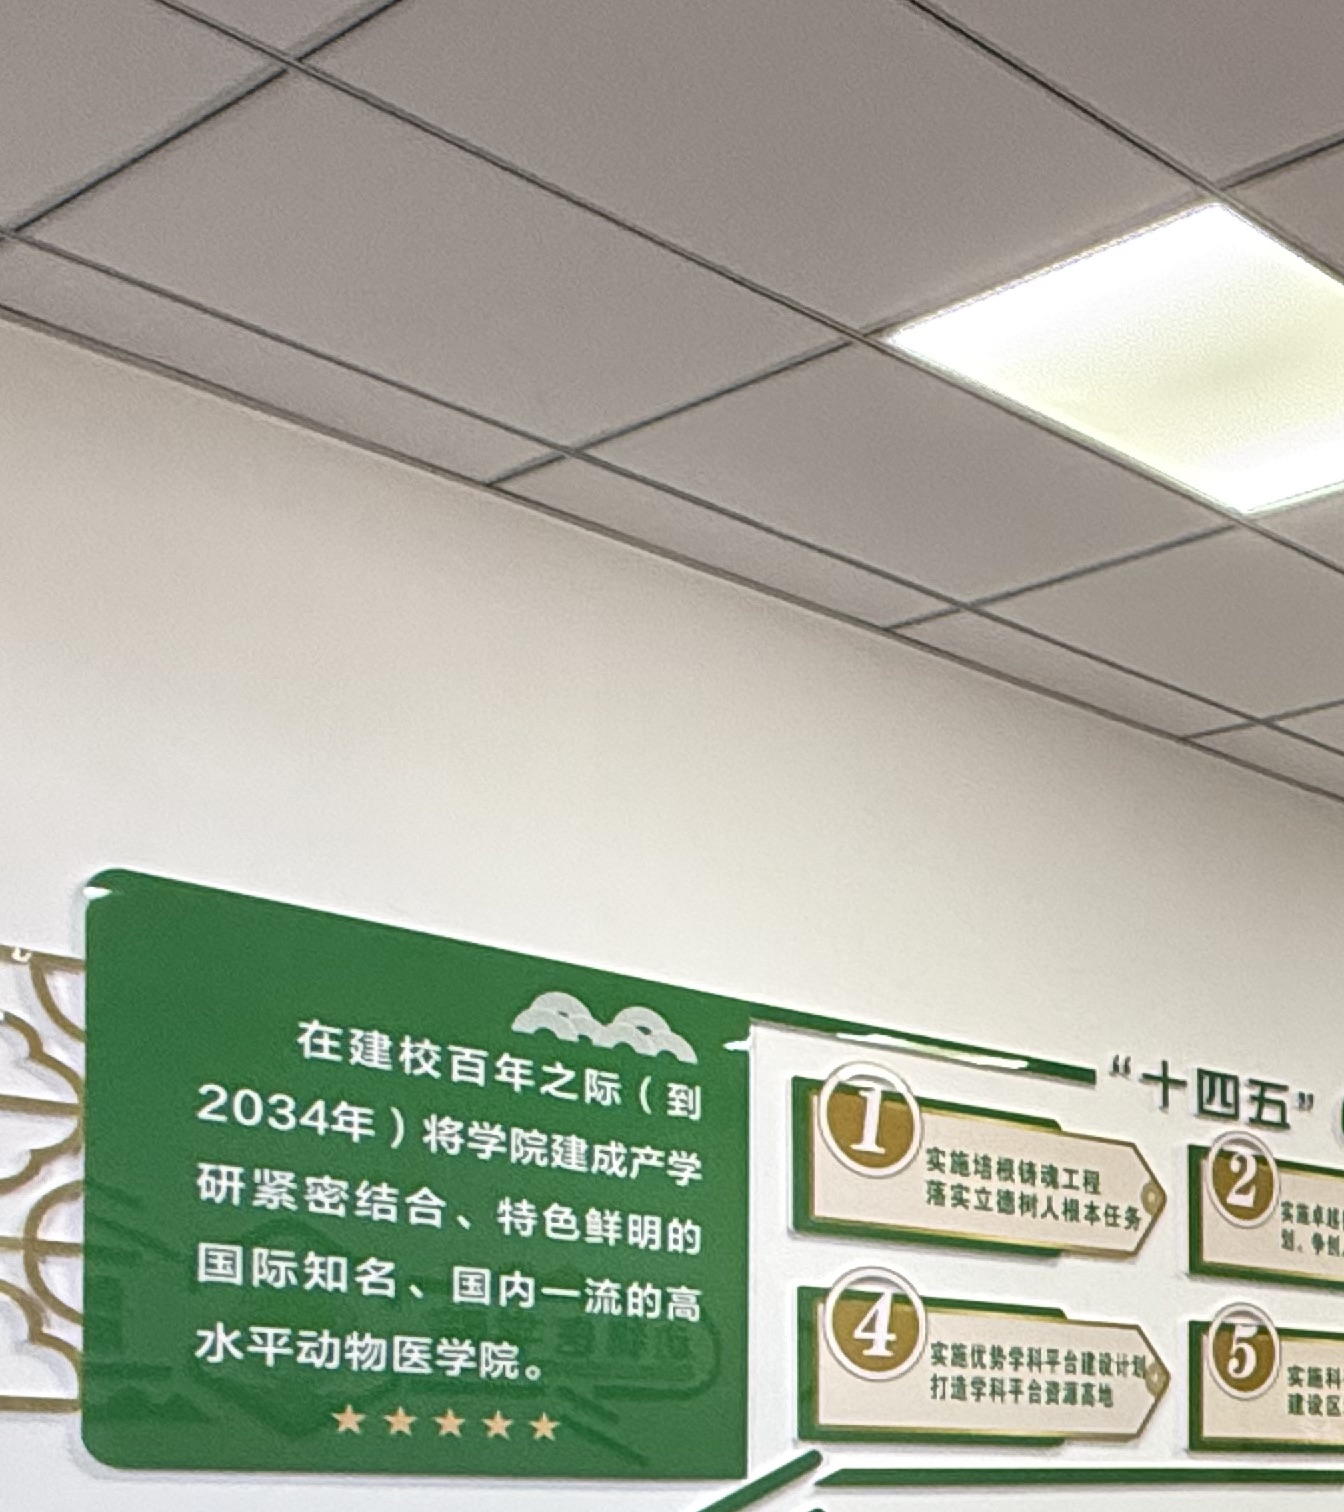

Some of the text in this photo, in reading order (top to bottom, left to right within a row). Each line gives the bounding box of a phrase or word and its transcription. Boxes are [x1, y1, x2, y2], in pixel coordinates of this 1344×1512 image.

[298, 1019, 702, 1120] 在建校百年之际（到
[197, 1084, 702, 1186] 2034年）将学院建成产学
[851, 1086, 886, 1154] 1
[926, 1147, 1101, 1195] 实施培根铸魂工程
[1226, 1151, 1258, 1208] 2
[197, 1163, 702, 1255] 研紧密结合、特色鲜明的
[926, 1179, 1142, 1231] 落实立德树人根本任务
[197, 1242, 702, 1322] 国际知名、国内一流的高
[195, 1322, 542, 1382] 水平动物医学院。
[853, 1291, 897, 1358] 4
[1228, 1323, 1258, 1380] 5
[930, 1341, 1147, 1379] 实施优势学科平台建设计划
[930, 1373, 1114, 1408] 打造学科平台资源高地
